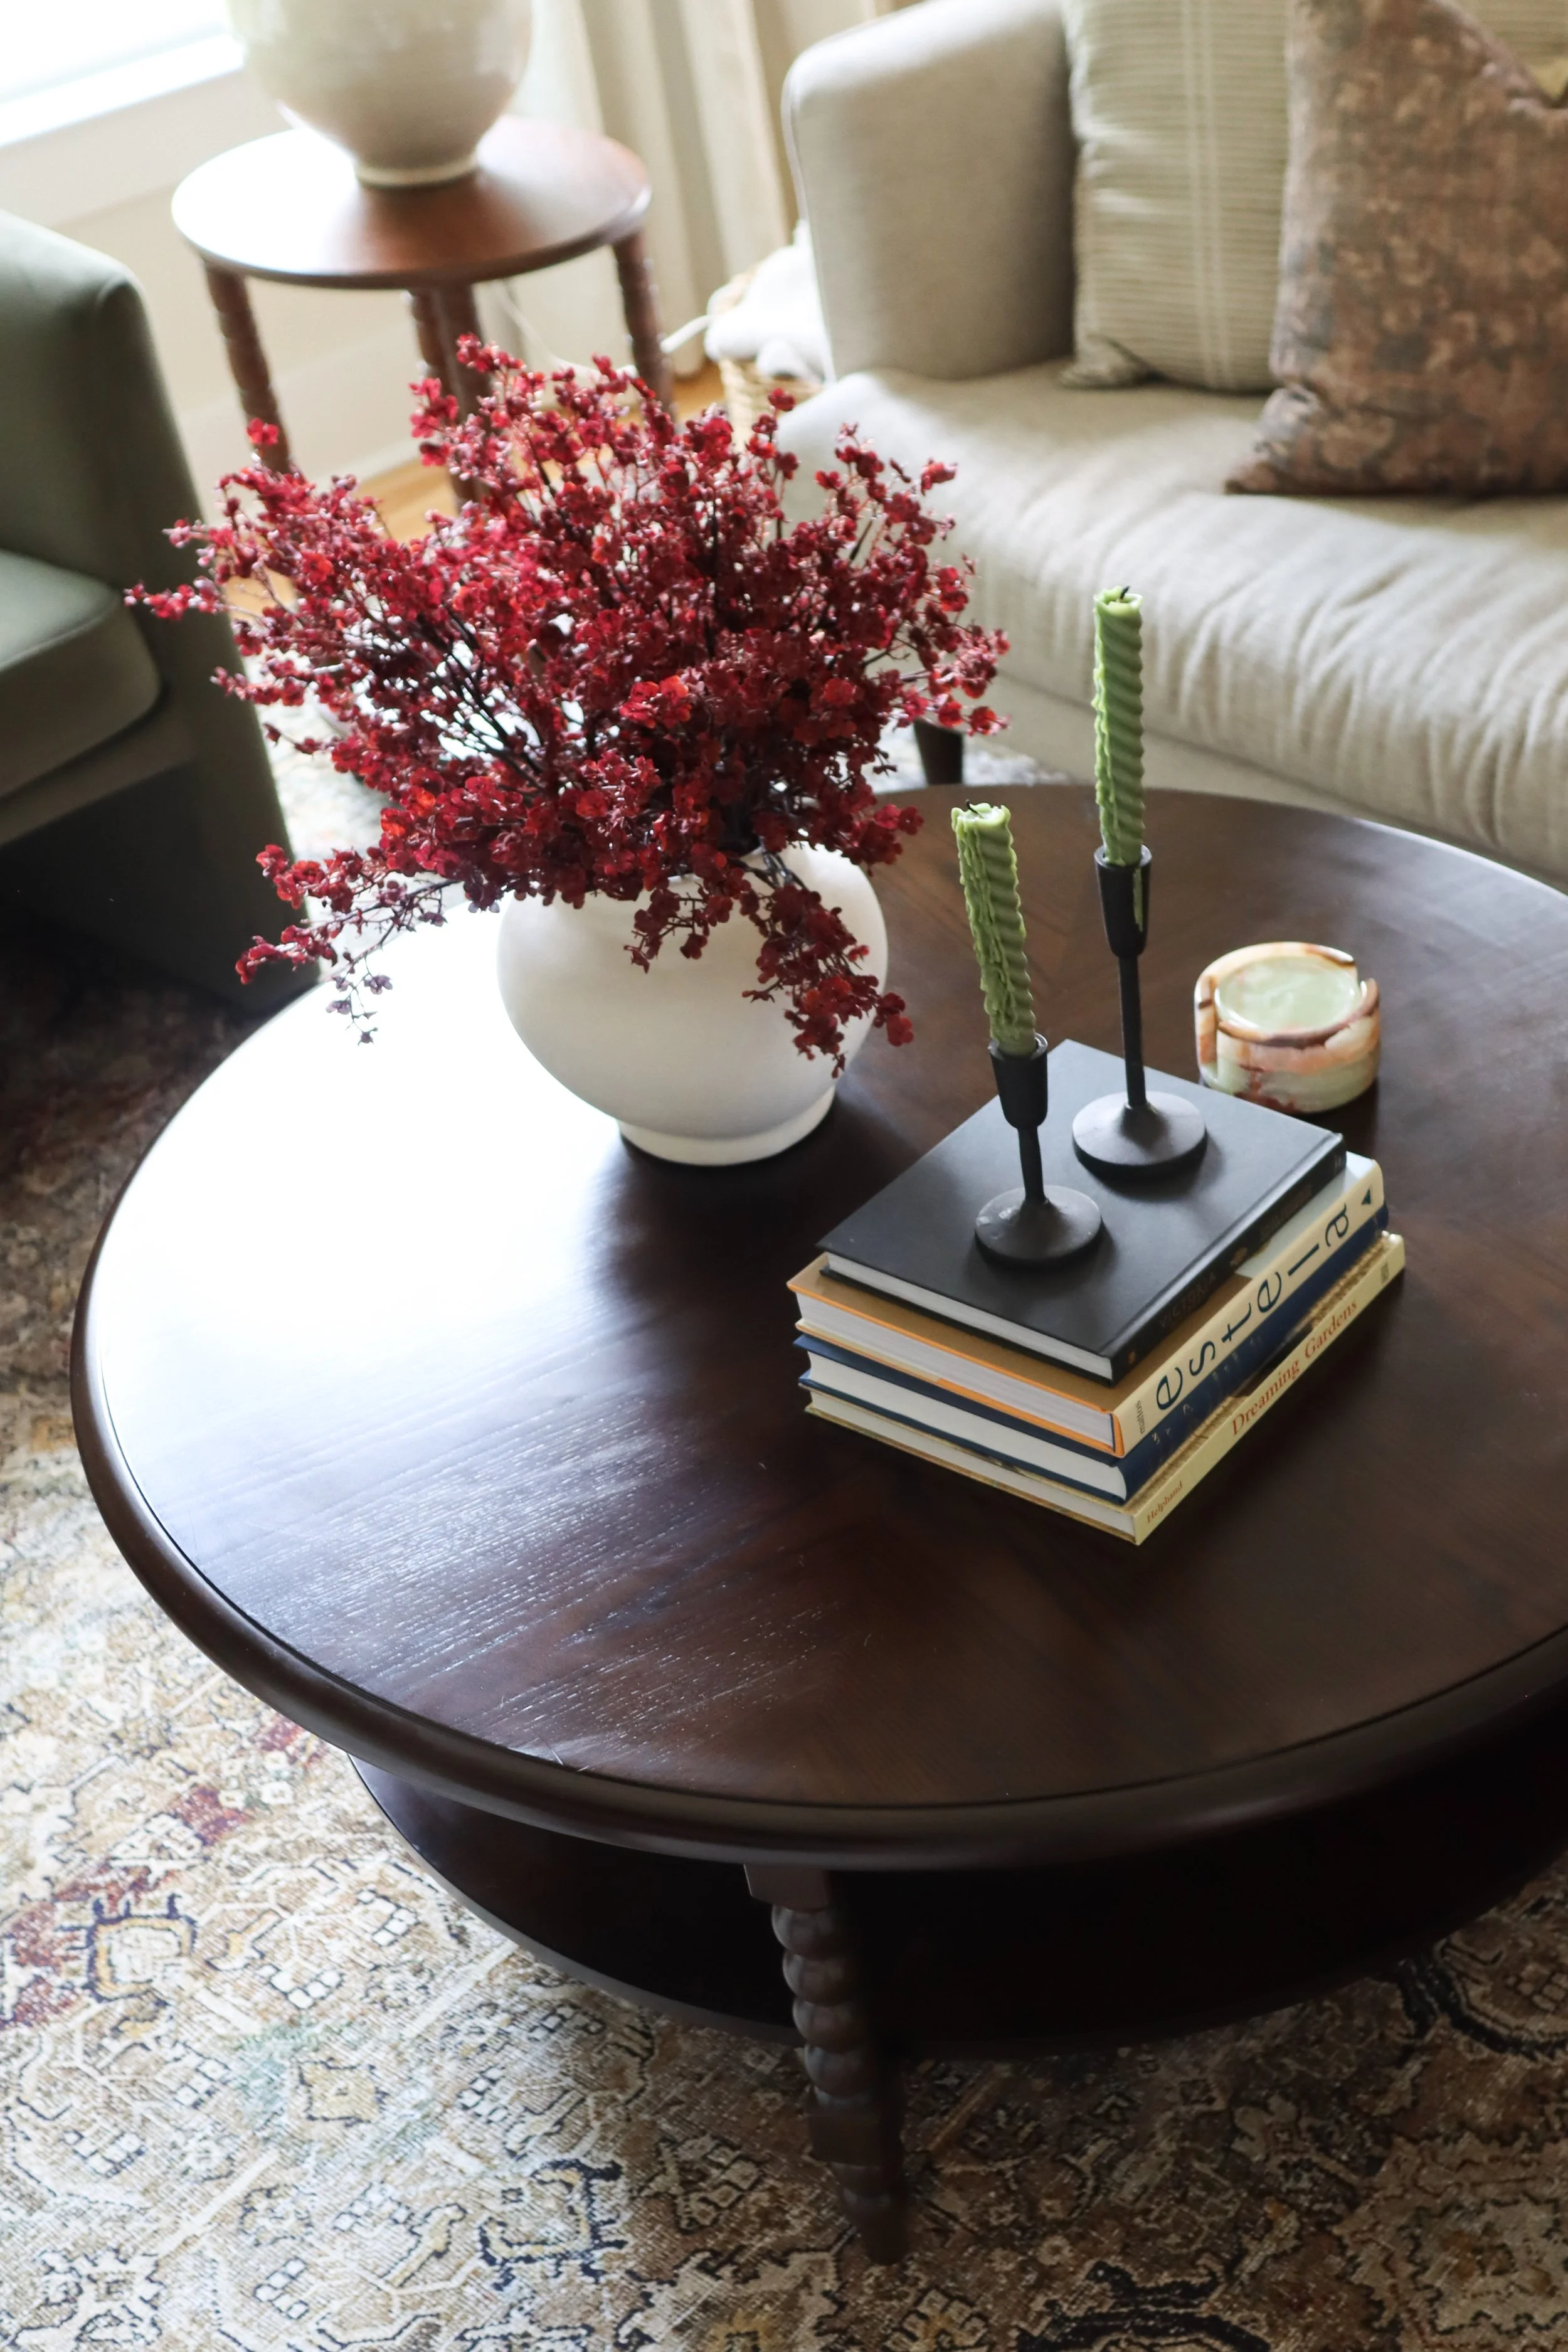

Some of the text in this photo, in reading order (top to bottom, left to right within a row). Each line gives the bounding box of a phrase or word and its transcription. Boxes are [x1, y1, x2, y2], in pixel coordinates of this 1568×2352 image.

[1156, 1202, 1350, 1411] estela
[1231, 1299, 1358, 1437] Dreaming Gardens
[1135, 1400, 1147, 1434] mattos
[1146, 1480, 1184, 1525] Helphand
